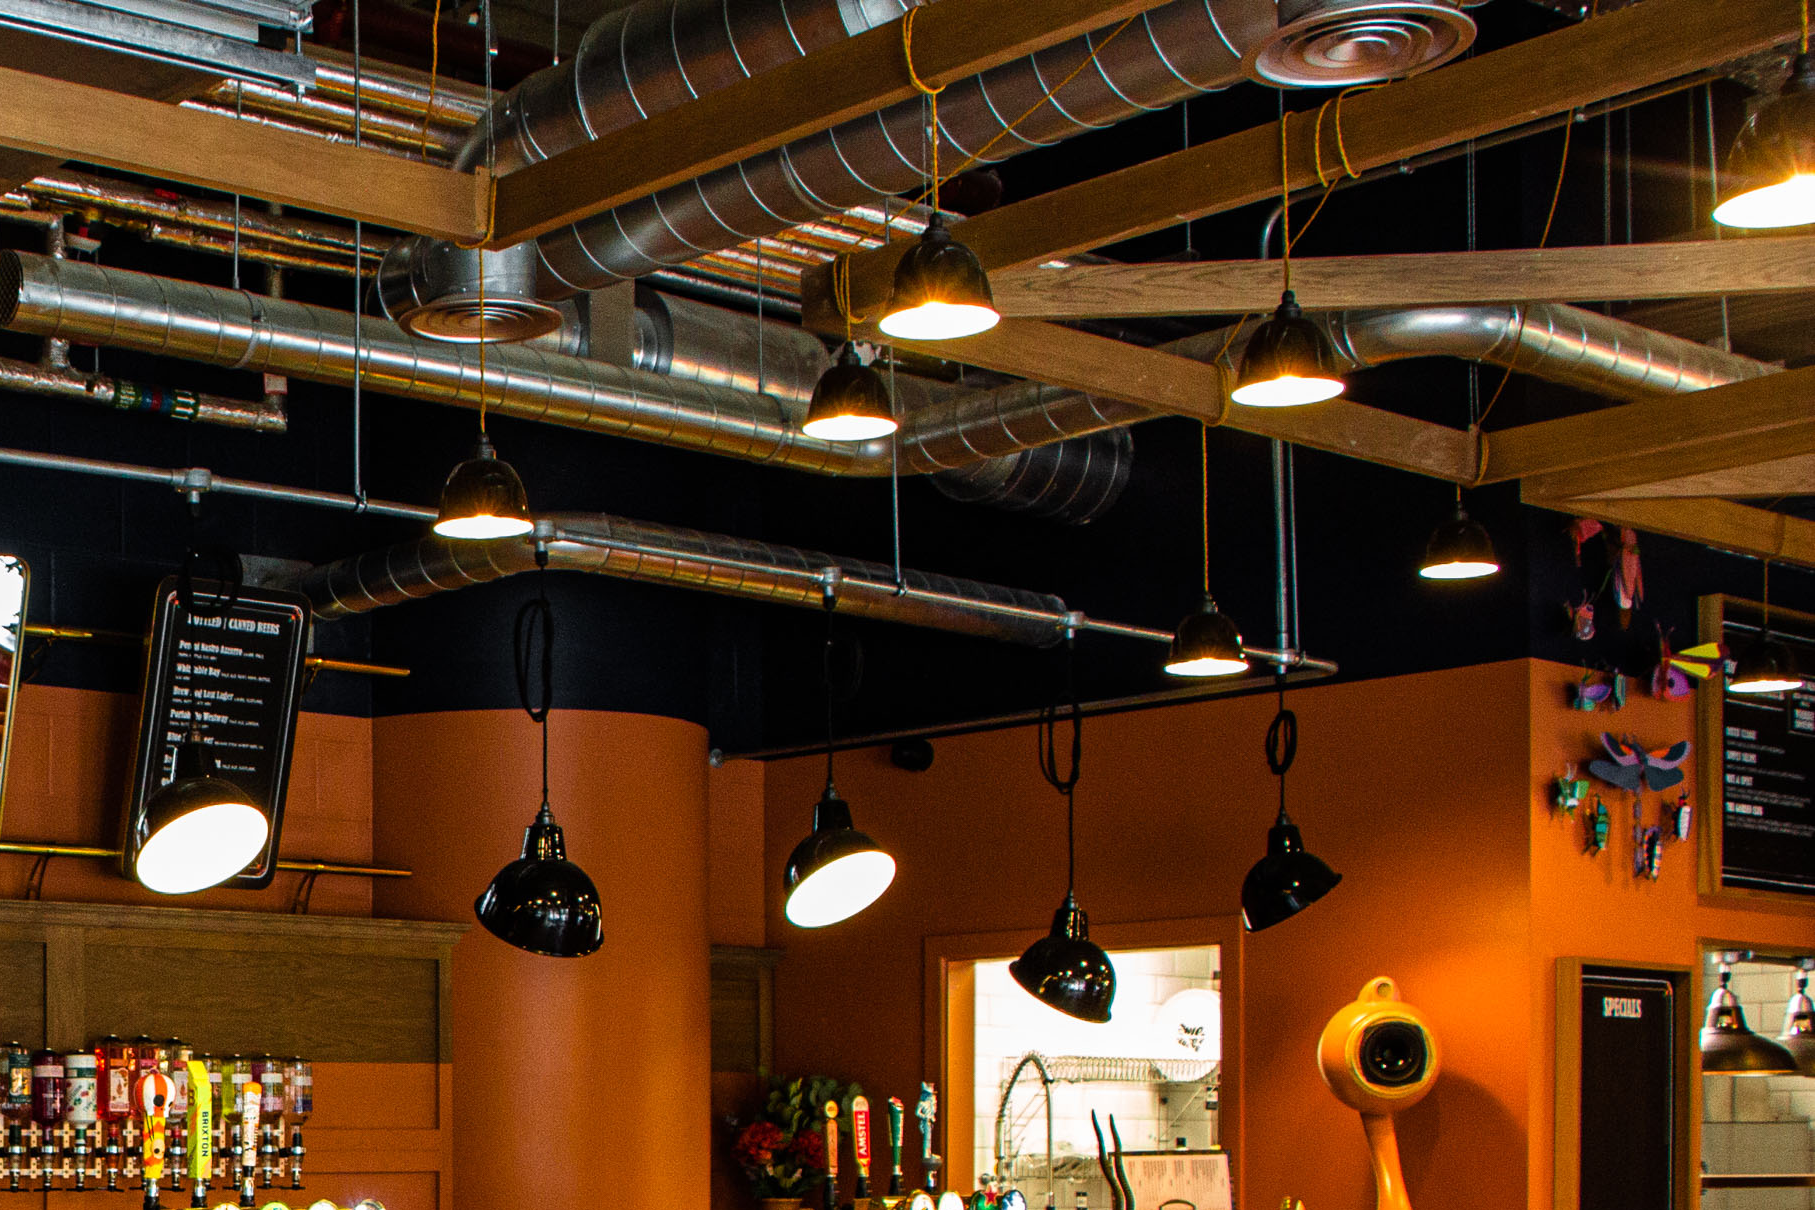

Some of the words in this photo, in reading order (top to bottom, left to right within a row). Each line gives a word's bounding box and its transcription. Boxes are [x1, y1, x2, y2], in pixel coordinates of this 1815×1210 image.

[228, 617, 256, 632] CANNED
[256, 621, 280, 635] BEERS
[201, 642, 220, 654] Nastro
[208, 665, 221, 678] Bay
[173, 685, 202, 699] Brewog
[216, 690, 234, 702] Lager
[1603, 996, 1642, 1018] SPECIALS
[857, 1112, 868, 1156] AMSTEL
